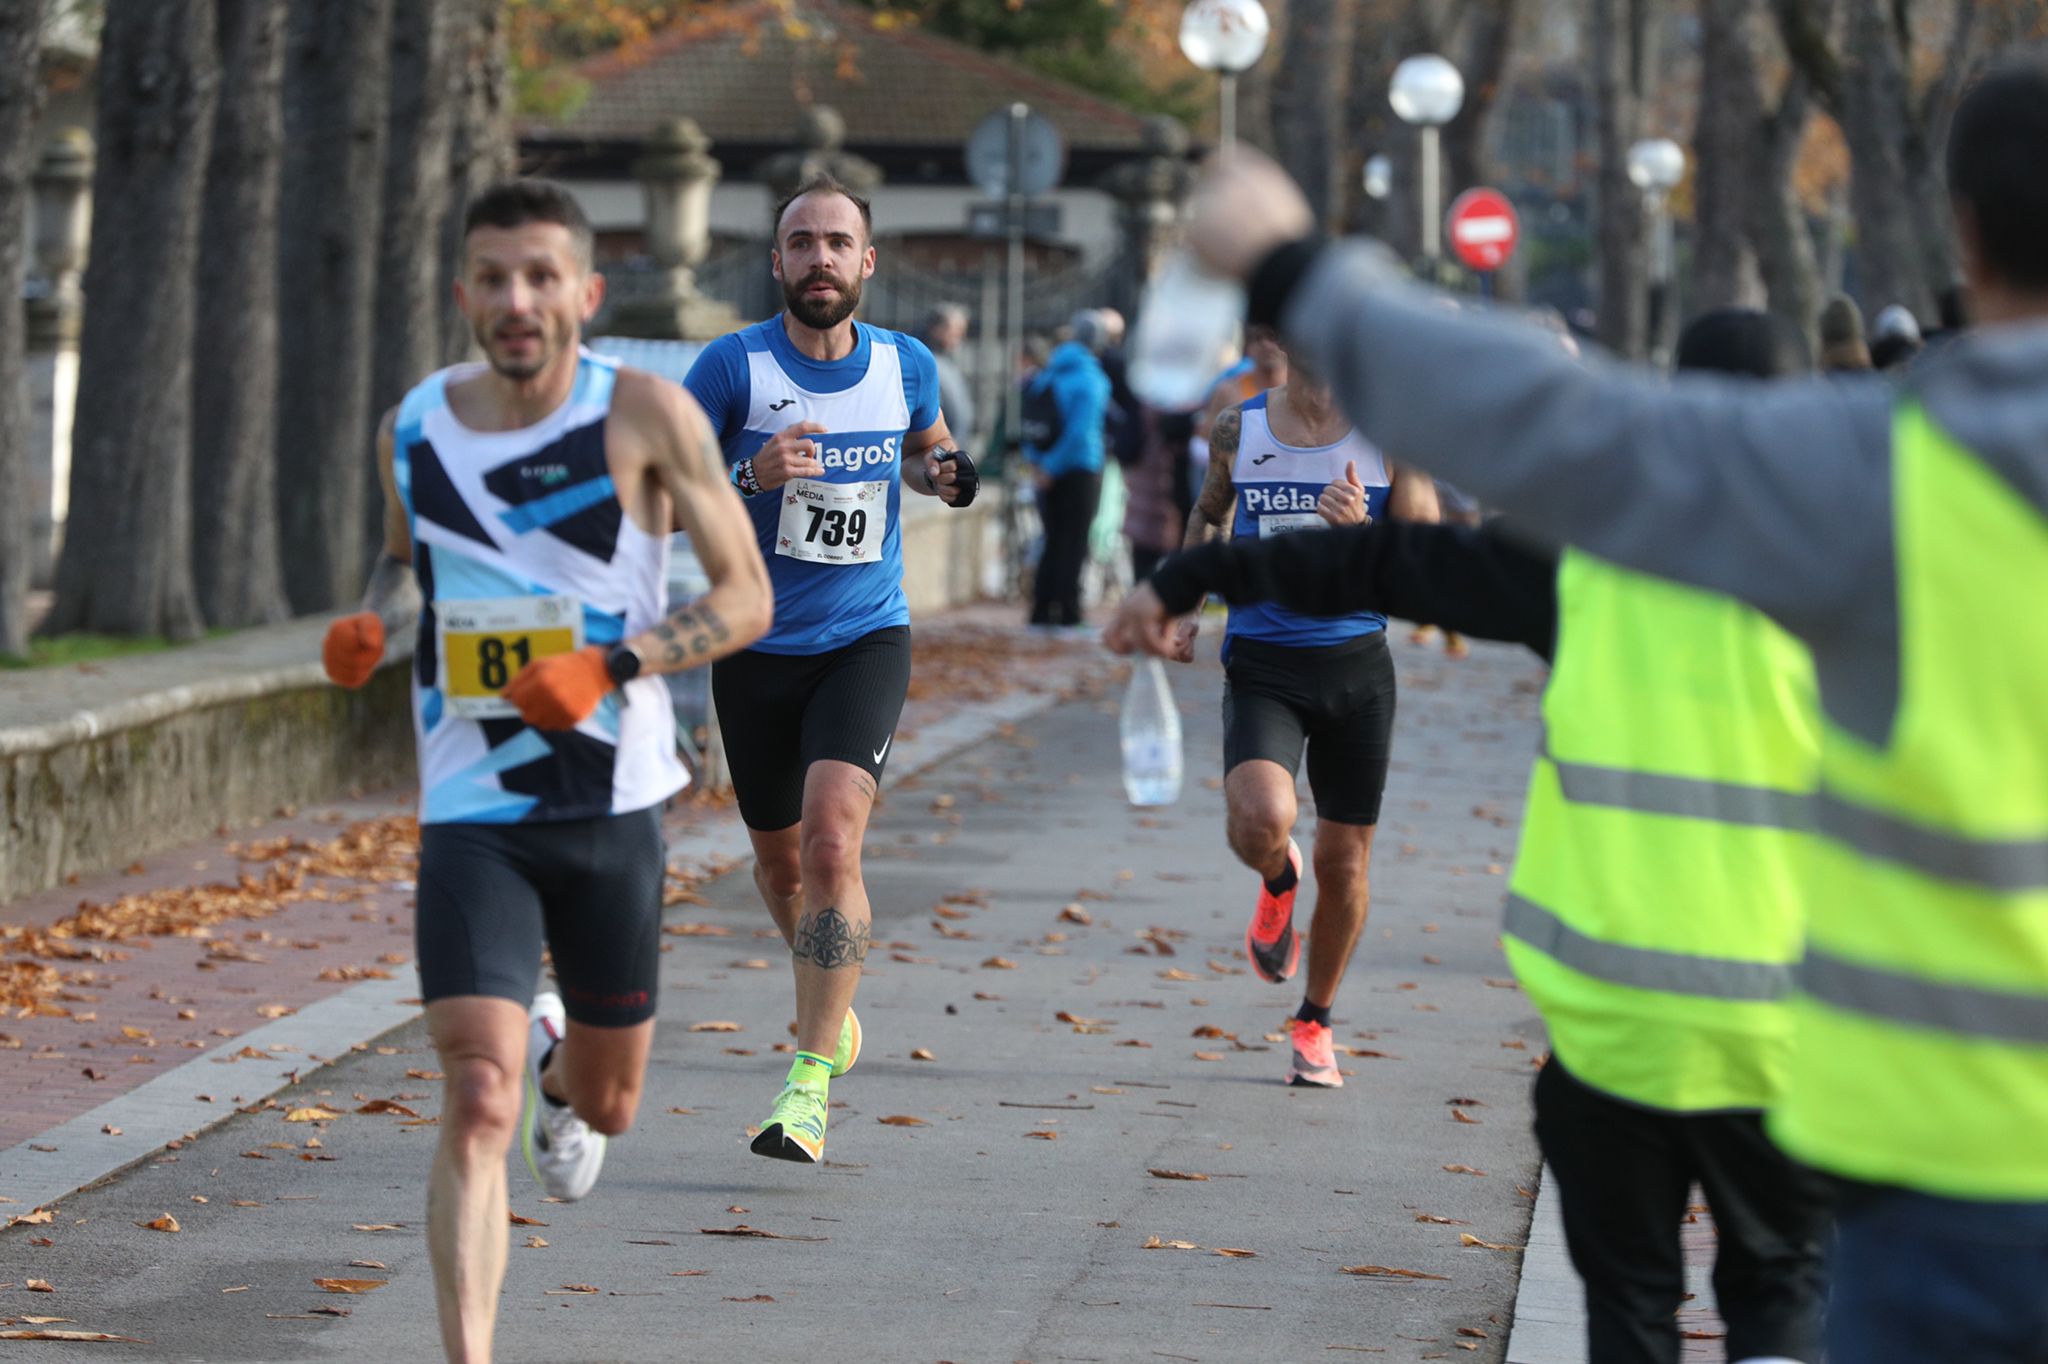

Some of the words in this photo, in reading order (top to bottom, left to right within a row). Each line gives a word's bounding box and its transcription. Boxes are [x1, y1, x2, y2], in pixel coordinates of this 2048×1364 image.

[796, 489, 824, 502] MEDIA
[797, 482, 809, 490] LA
[805, 504, 867, 547] 739
[478, 635, 531, 690] 81
